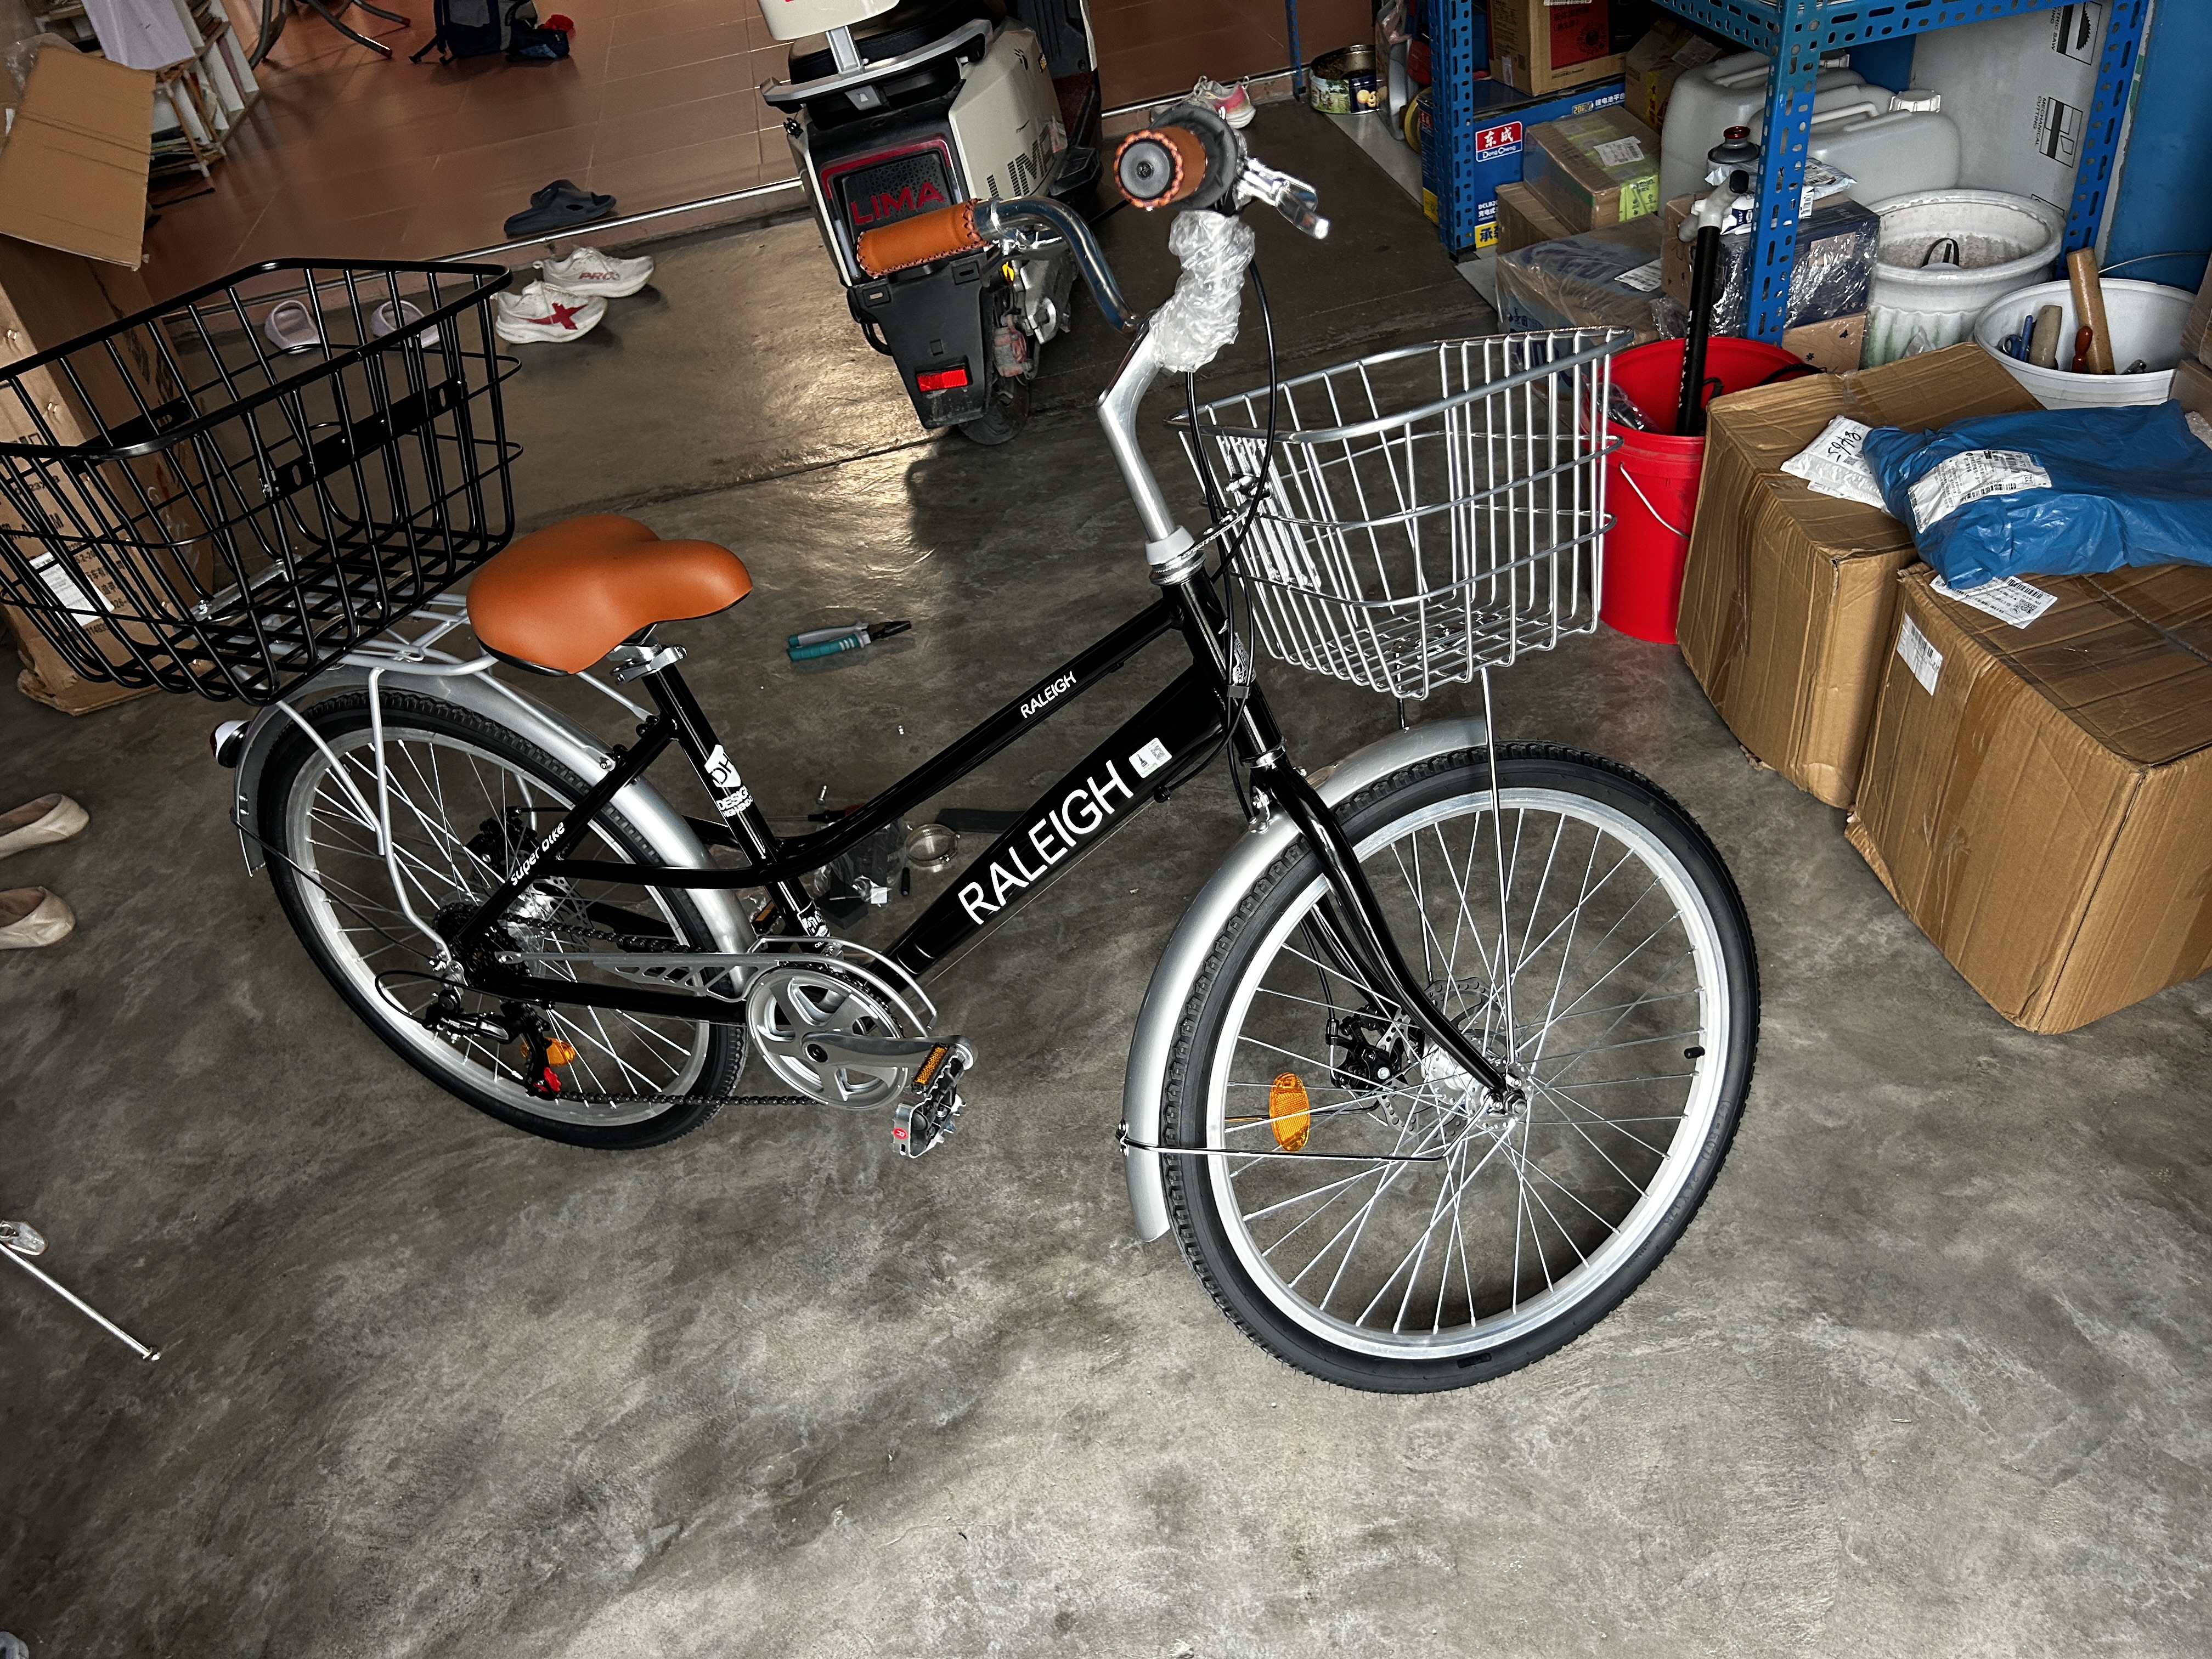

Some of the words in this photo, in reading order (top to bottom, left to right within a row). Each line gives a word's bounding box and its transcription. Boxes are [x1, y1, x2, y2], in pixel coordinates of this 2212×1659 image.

[2033, 95, 2042, 129] CUTTING
[2035, 98, 2047, 146] MECHANICAL
[851, 182, 946, 225] LIMA
[1020, 670, 1077, 719] RALEIGH
[715, 785, 748, 810] DESIG
[958, 759, 1134, 926] RALEIGH
[511, 847, 539, 885] super
